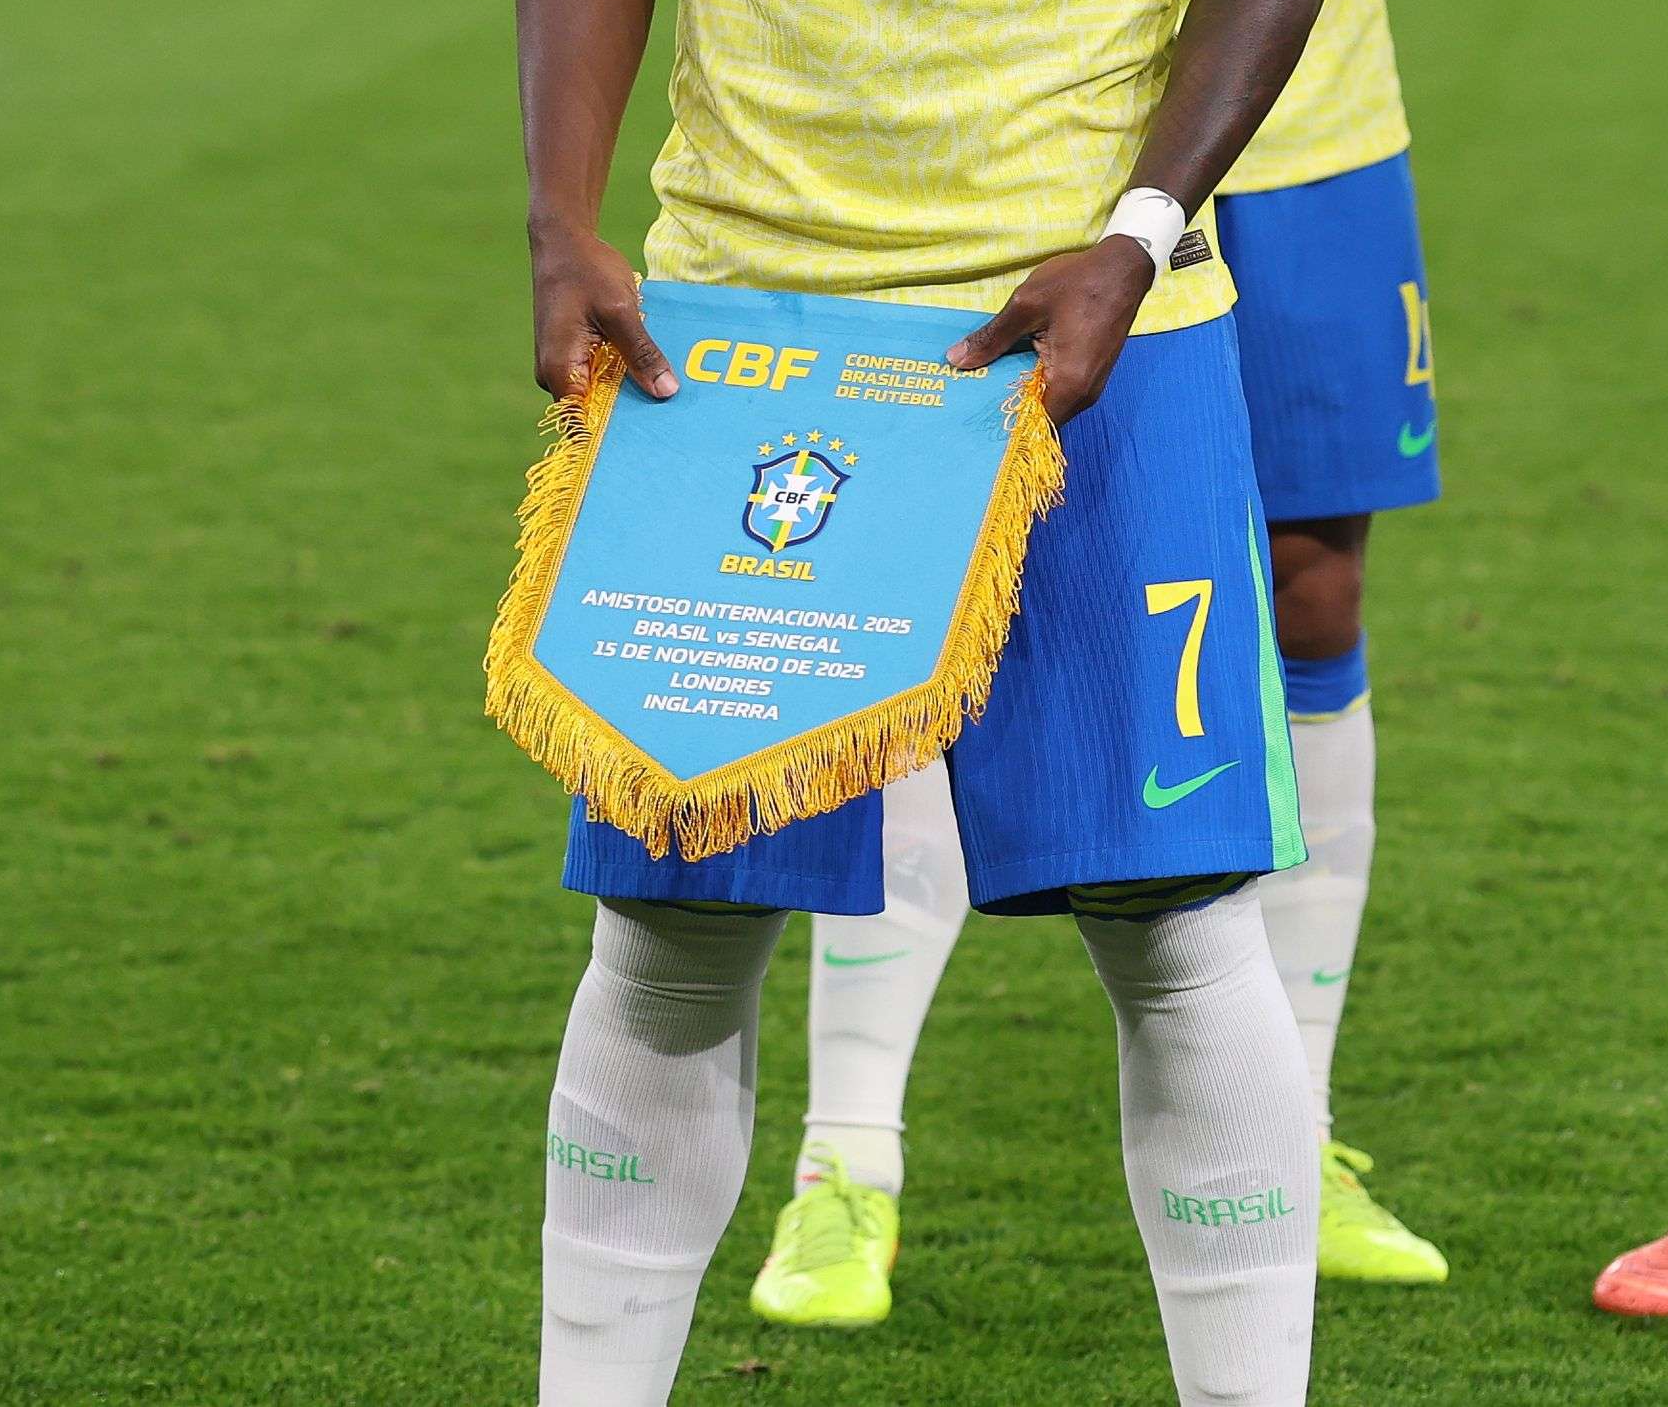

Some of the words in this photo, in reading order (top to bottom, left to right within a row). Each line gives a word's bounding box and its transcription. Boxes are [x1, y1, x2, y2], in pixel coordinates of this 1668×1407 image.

[684, 338, 820, 392] CBF
[839, 368, 946, 392] BRASILEIRA
[835, 384, 861, 399] DE
[863, 388, 945, 407] FUTEBOL
[774, 491, 810, 505] CBF
[720, 553, 816, 581] BRASIL
[581, 589, 692, 616] AMISTOSO
[693, 601, 859, 631] INTERNACIONAL
[863, 616, 913, 634] 2025
[633, 619, 711, 642] BRASIL
[716, 631, 740, 645] vs
[743, 630, 842, 654] SENEGAL
[592, 640, 618, 657] 15
[620, 643, 653, 660] DE
[654, 646, 779, 673] NOVEMBRO
[782, 658, 814, 675] DE
[815, 661, 867, 679] 2025
[1145, 579, 1214, 738] 7
[669, 671, 773, 696] LONDRES
[643, 693, 779, 721] INGLATERRA
[549, 1132, 657, 1184] RASIL
[1161, 1185, 1295, 1227] BRASIL
